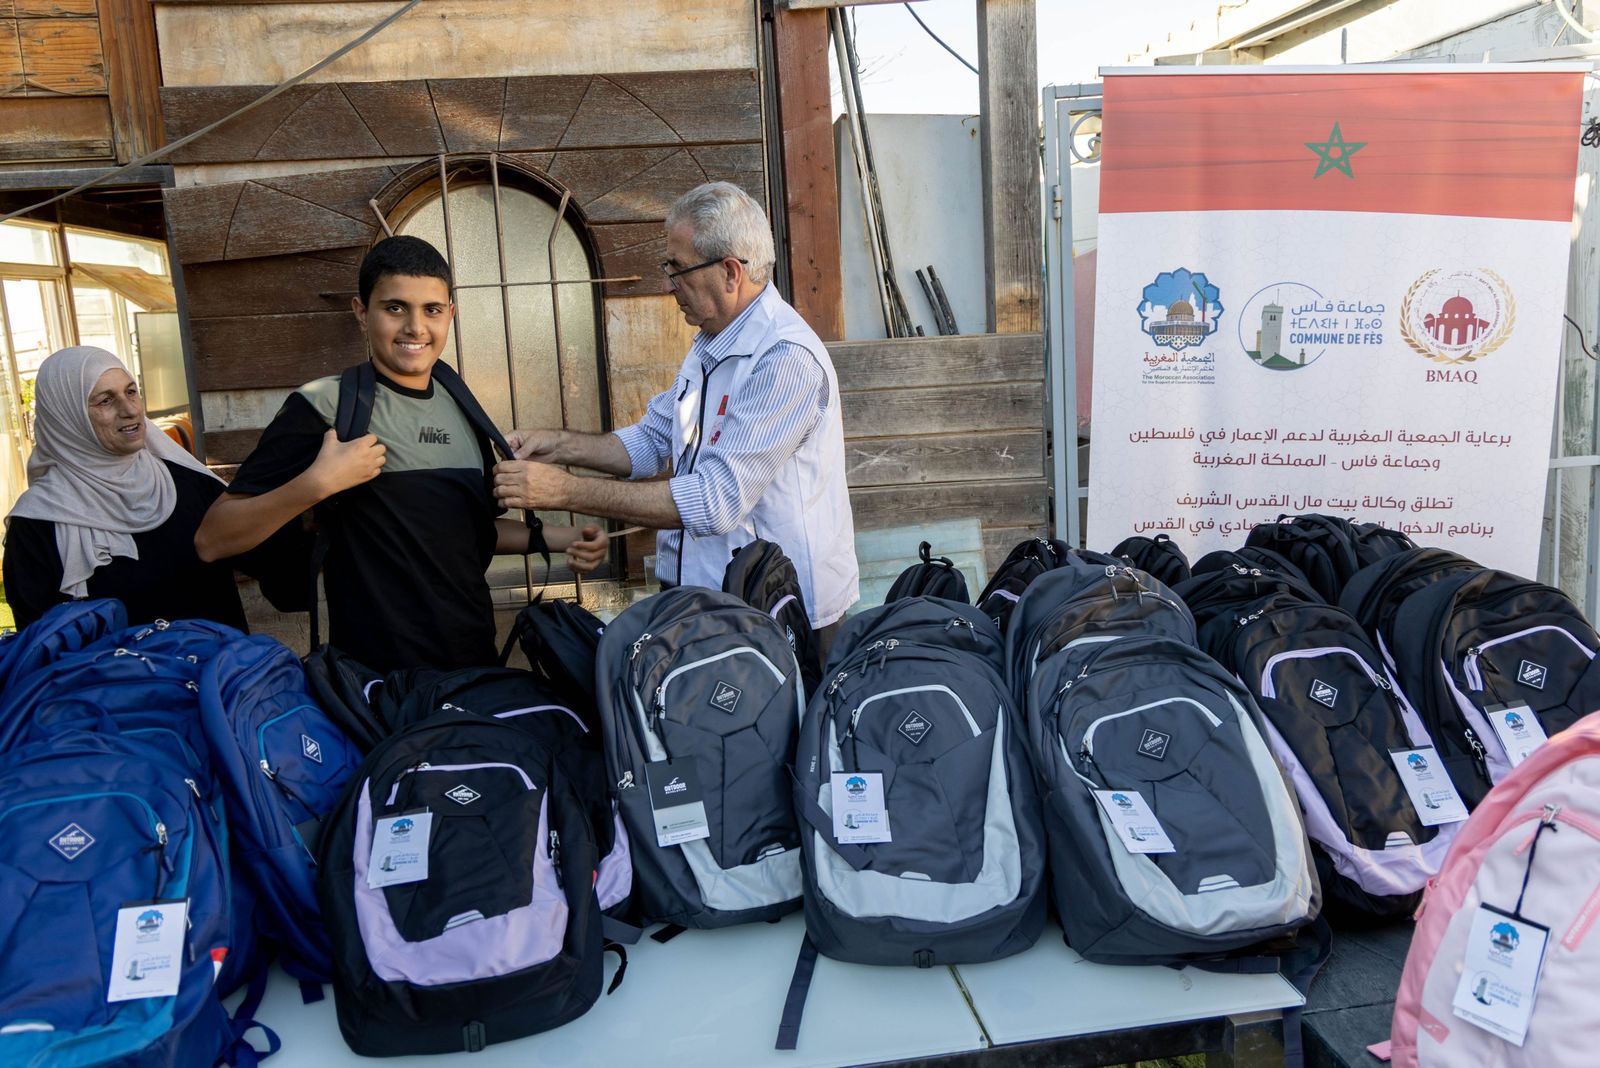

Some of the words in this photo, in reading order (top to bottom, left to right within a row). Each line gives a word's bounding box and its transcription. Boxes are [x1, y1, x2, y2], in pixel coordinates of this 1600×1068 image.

[1291, 300, 1334, 316] فاس
[1337, 301, 1385, 316] جماعة
[1289, 333, 1345, 344] COMMUNE
[1347, 333, 1361, 344] DE
[1143, 352, 1178, 367] المغربية
[1425, 370, 1478, 385] BMAQ
[418, 426, 451, 445] NIKE
[1129, 427, 1195, 444] فلسطين
[1200, 427, 1226, 447] في
[1231, 428, 1278, 445] الإعمار
[1282, 429, 1324, 444] لدعم
[1328, 429, 1393, 446] المغربية
[1397, 429, 1460, 447] الجمعية
[1465, 430, 1512, 447] برعاية
[1193, 451, 1257, 469] المغربية
[1261, 452, 1326, 467] المملكة
[1341, 454, 1378, 471] فاس
[1382, 454, 1441, 472] وجماعة
[1176, 491, 1232, 509] الشريف
[1236, 494, 1290, 510] القدس
[1294, 495, 1323, 511] مال
[1326, 496, 1358, 512] بيت
[1361, 495, 1406, 513] وكالة
[1410, 496, 1453, 513] تطلق
[1134, 517, 1185, 534] القدس
[1189, 517, 1215, 537] في
[1447, 522, 1494, 539] برنامج
[664, 782, 686, 792] OUTDOOR
